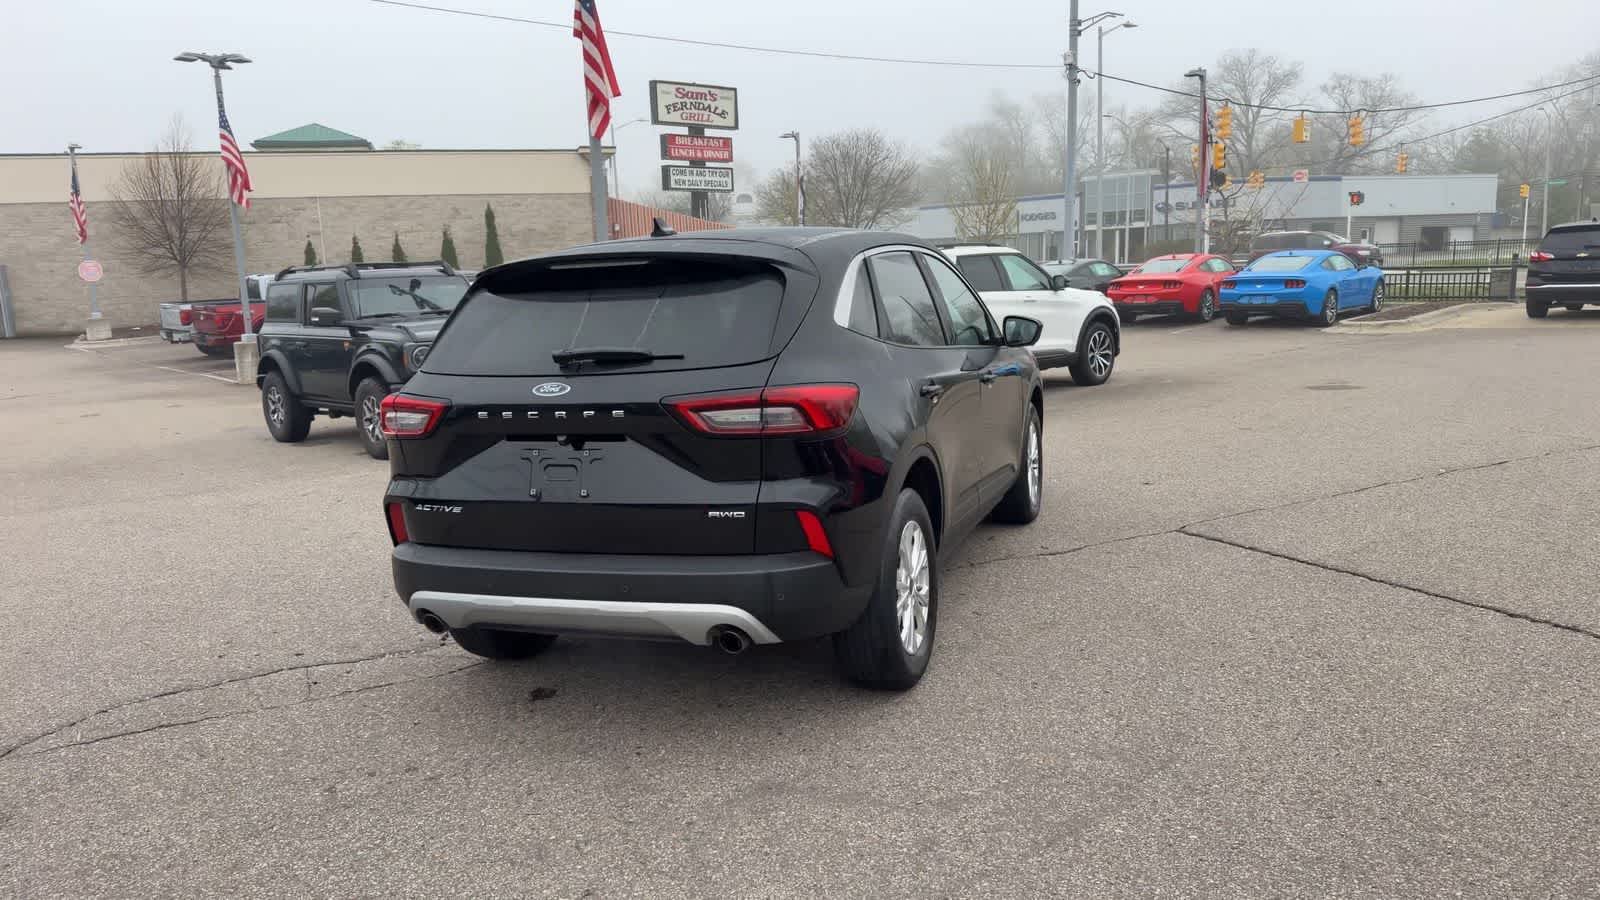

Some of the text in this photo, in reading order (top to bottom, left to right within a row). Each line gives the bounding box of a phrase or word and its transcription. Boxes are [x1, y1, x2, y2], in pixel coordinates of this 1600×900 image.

[674, 87, 718, 102] Sam's
[664, 101, 728, 119] FERNDALE
[680, 112, 713, 122] GRILL
[675, 136, 723, 147] BREAKFAST
[671, 148, 695, 157] LUNCH
[703, 150, 729, 159] DINNER
[674, 178, 728, 188] NEW DAILY SPECIALS
[1176, 200, 1236, 211] SUARU
[540, 384, 562, 393] Ford
[478, 410, 625, 419] ESCAPE
[415, 504, 463, 513] ACTIVE
